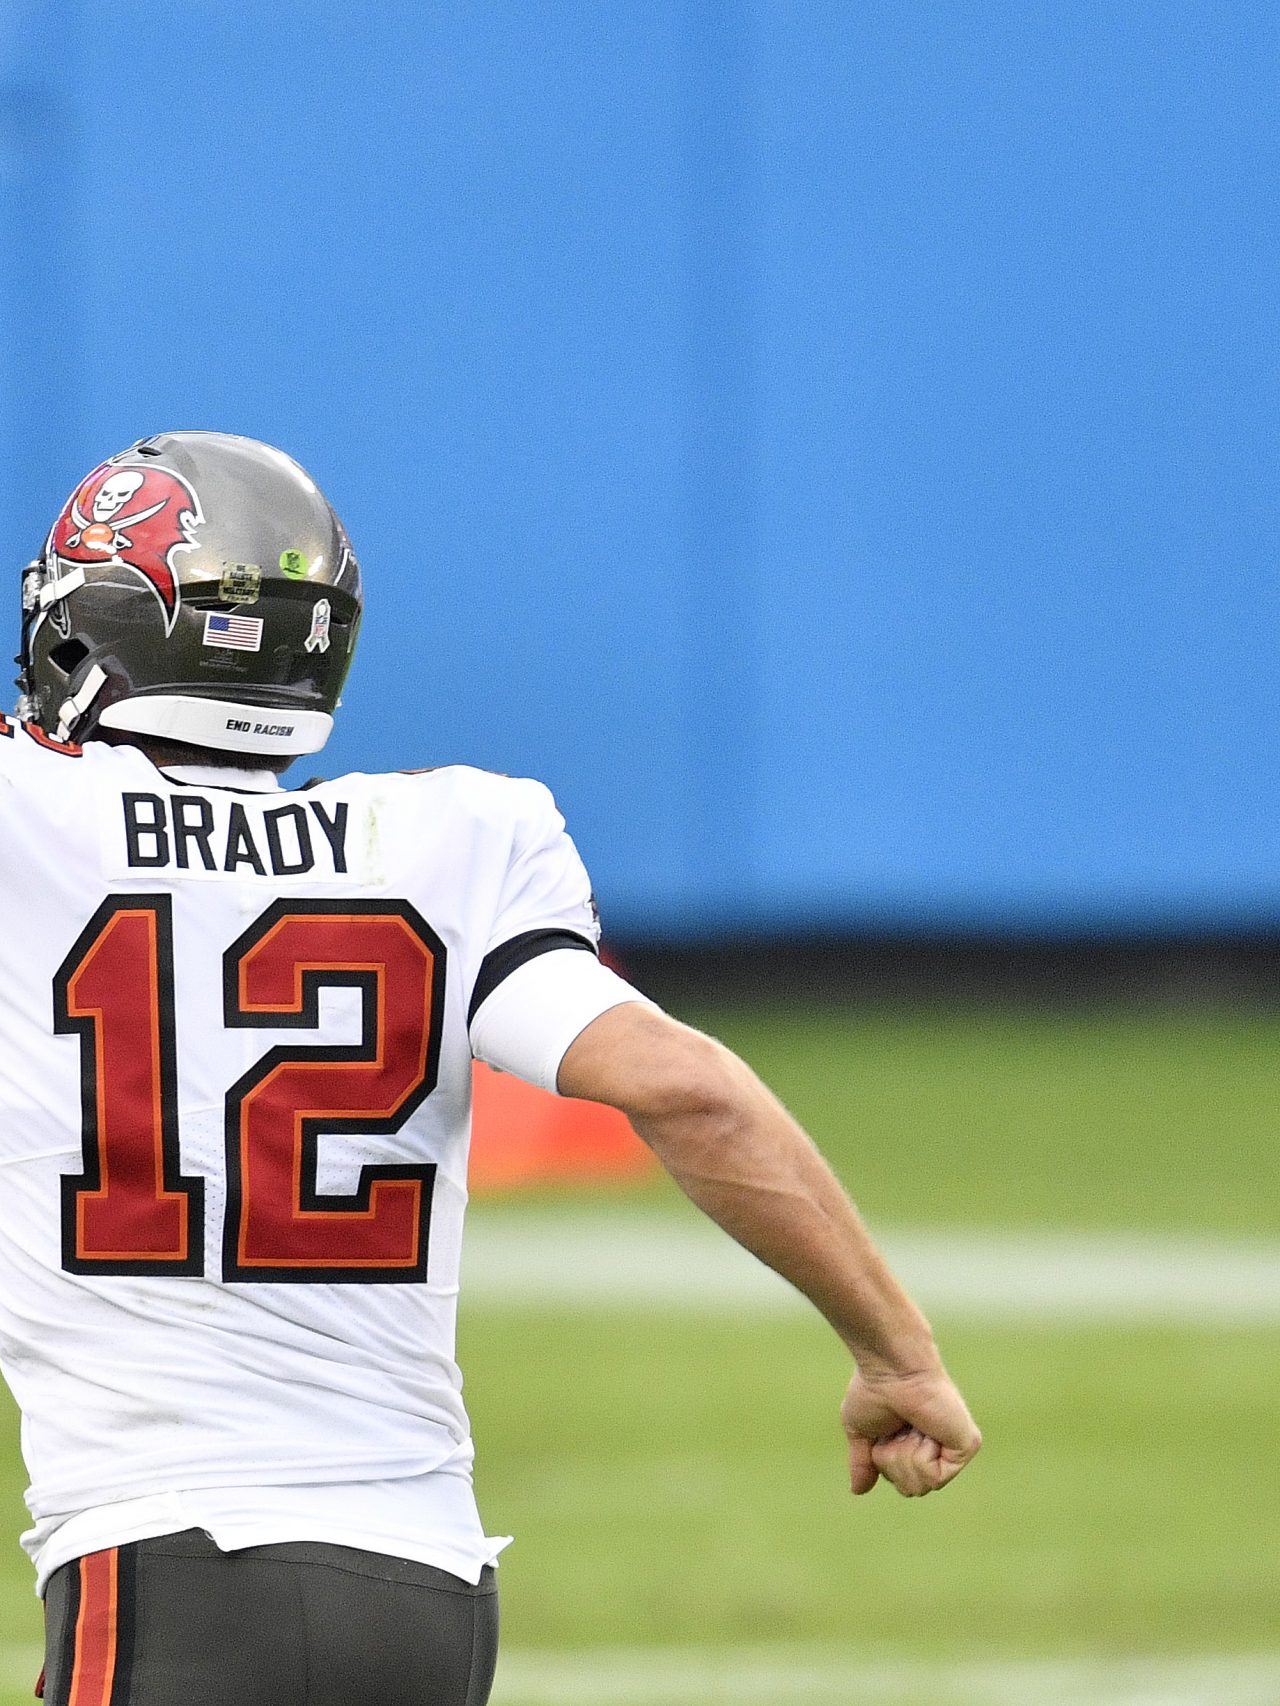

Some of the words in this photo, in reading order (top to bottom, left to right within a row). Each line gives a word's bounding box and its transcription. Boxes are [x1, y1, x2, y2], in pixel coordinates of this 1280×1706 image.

[226, 719, 251, 732] END
[253, 723, 295, 736] RACISM
[122, 792, 348, 875] BRADY
[52, 893, 447, 1284] 12
